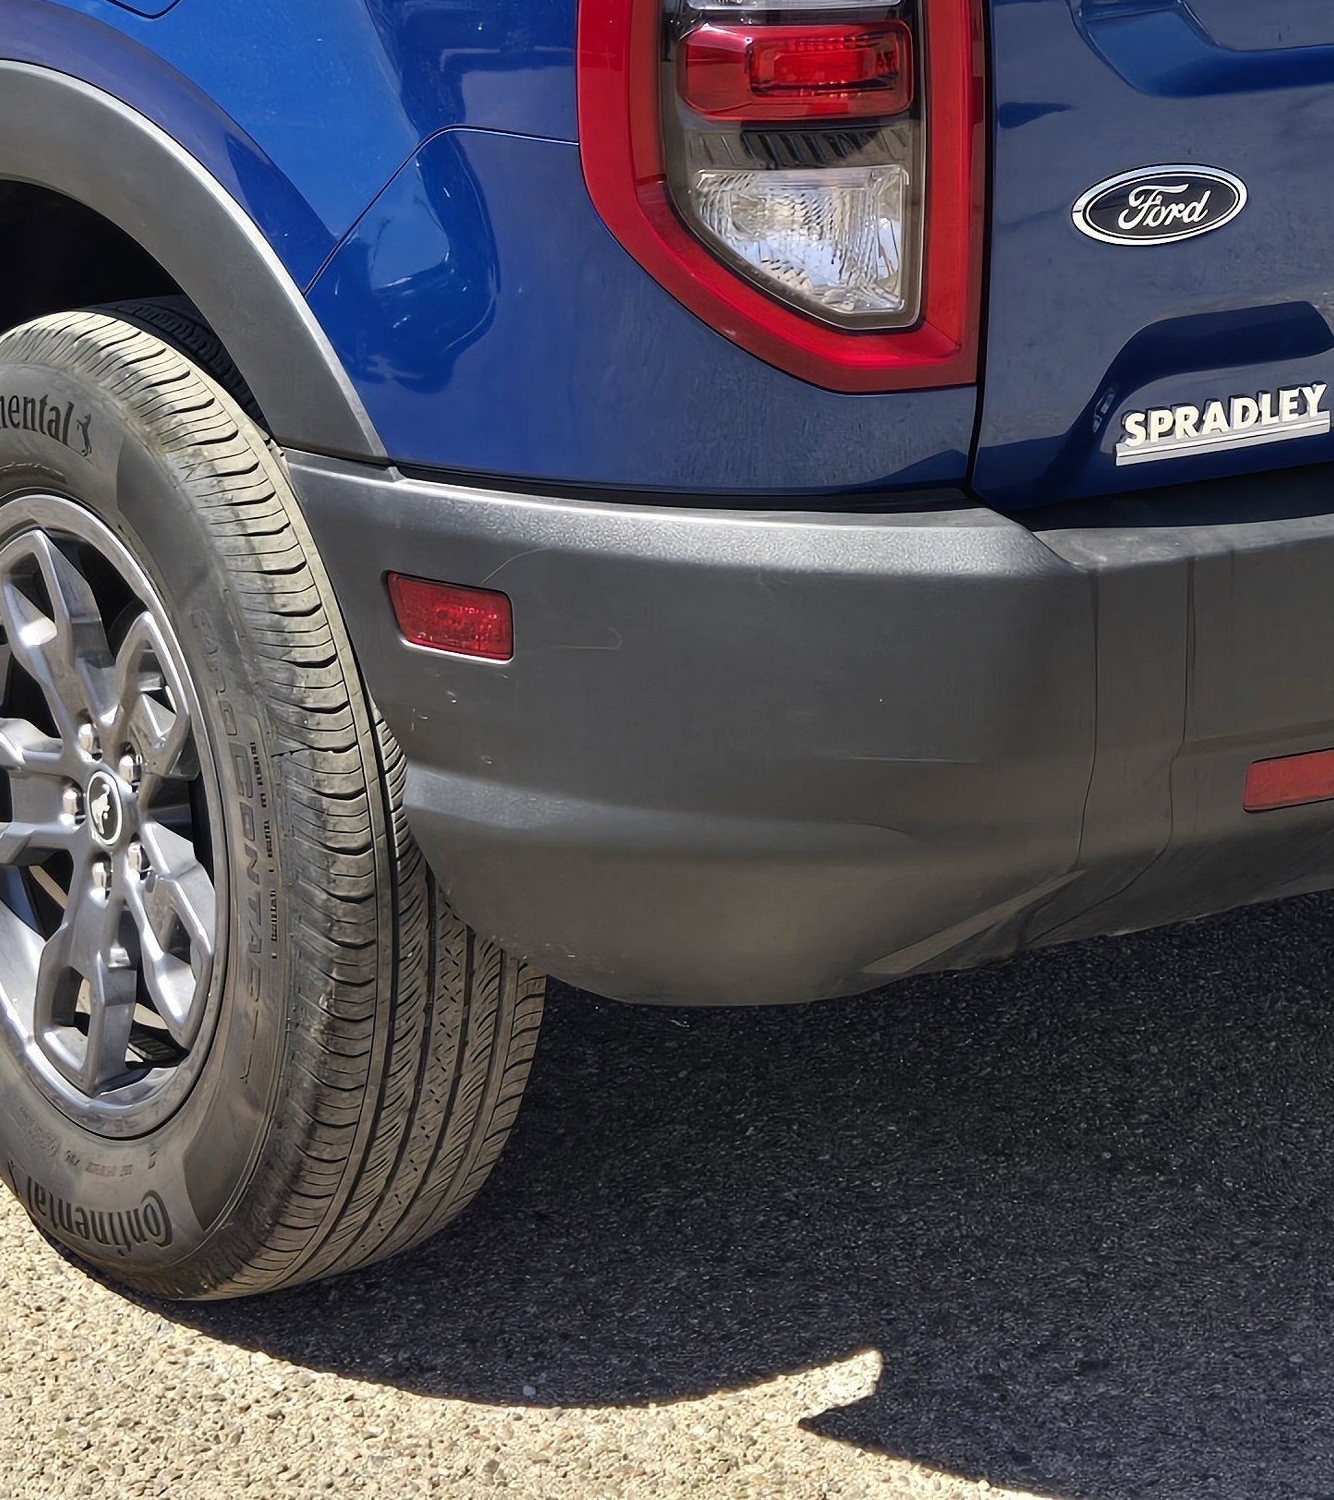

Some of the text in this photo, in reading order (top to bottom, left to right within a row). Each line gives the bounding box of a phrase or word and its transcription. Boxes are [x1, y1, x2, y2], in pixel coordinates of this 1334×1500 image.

[1118, 183, 1212, 231] Ford
[1123, 382, 1328, 448] SPRADLEY
[26, 1175, 174, 1258] Continental
